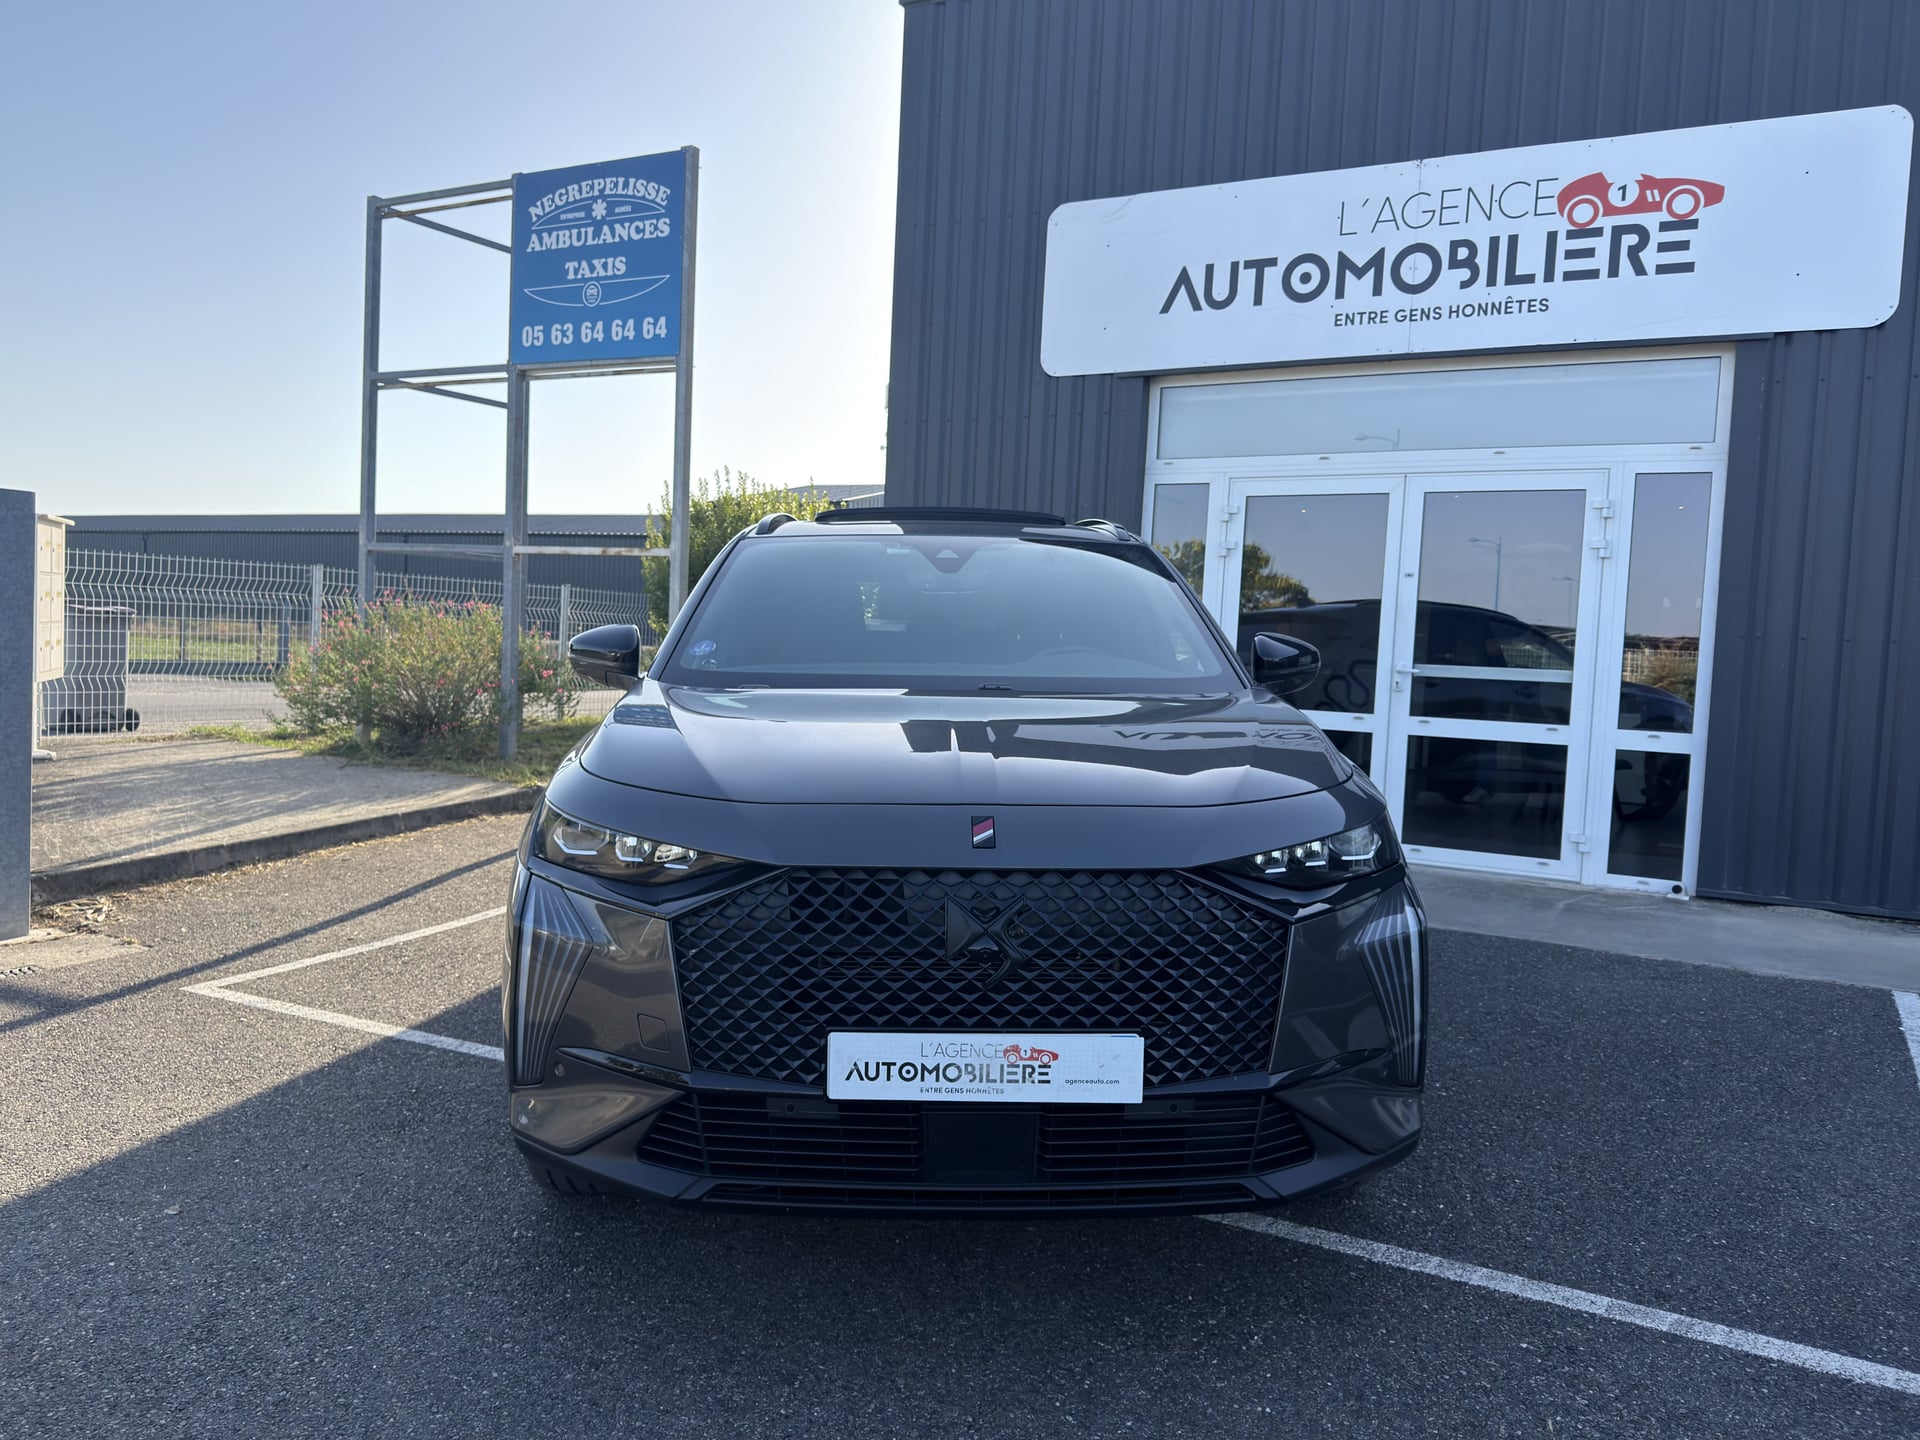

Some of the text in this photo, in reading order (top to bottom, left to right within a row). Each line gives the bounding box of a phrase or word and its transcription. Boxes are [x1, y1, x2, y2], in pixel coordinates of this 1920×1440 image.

[528, 177, 671, 223] NEGREPELISSE
[1339, 177, 1559, 236] L'AGENCE
[526, 218, 671, 253] AMBULANCES
[564, 256, 627, 280] TAXIS
[1334, 296, 1550, 327] ENTRE GENS HONNÊTES
[521, 316, 667, 347] 05 63 64 64 64
[920, 1042, 1004, 1059] L'AGENCE
[920, 1086, 943, 1094] ENTRE
[944, 1086, 965, 1094] GENS
